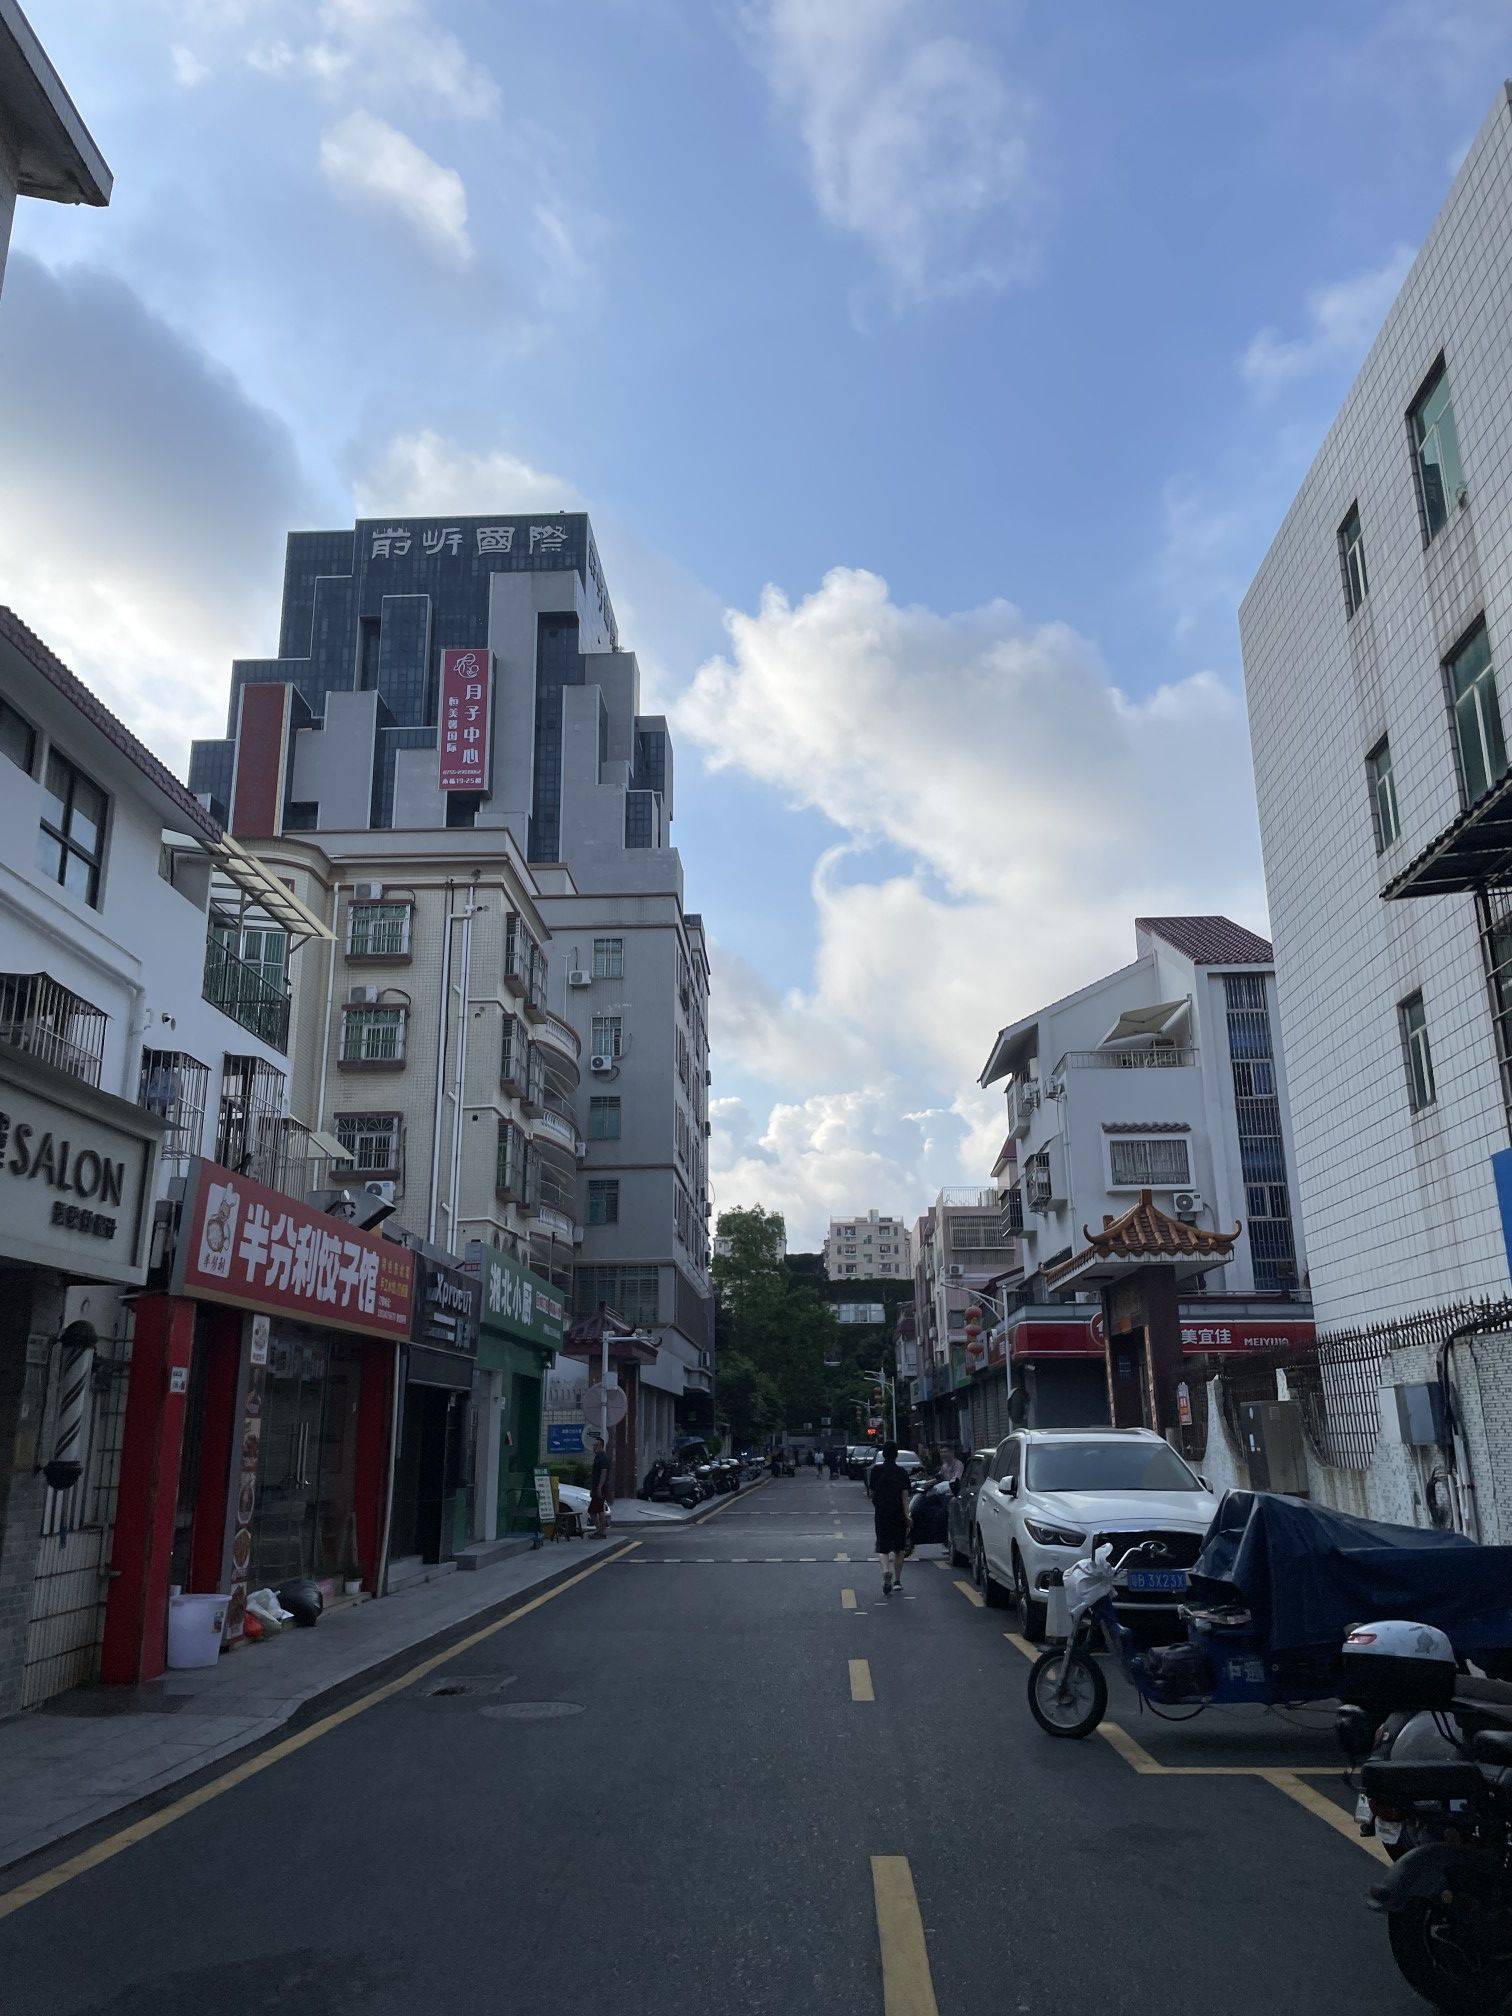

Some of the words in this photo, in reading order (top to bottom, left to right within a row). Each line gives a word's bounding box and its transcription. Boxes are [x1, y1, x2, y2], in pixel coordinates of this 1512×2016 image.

[462, 684, 482, 764] 月子中心
[9, 1123, 125, 1207] SALON
[238, 1203, 379, 1314] 半分利饺子馆
[1180, 1328, 1232, 1345] 美宜佳
